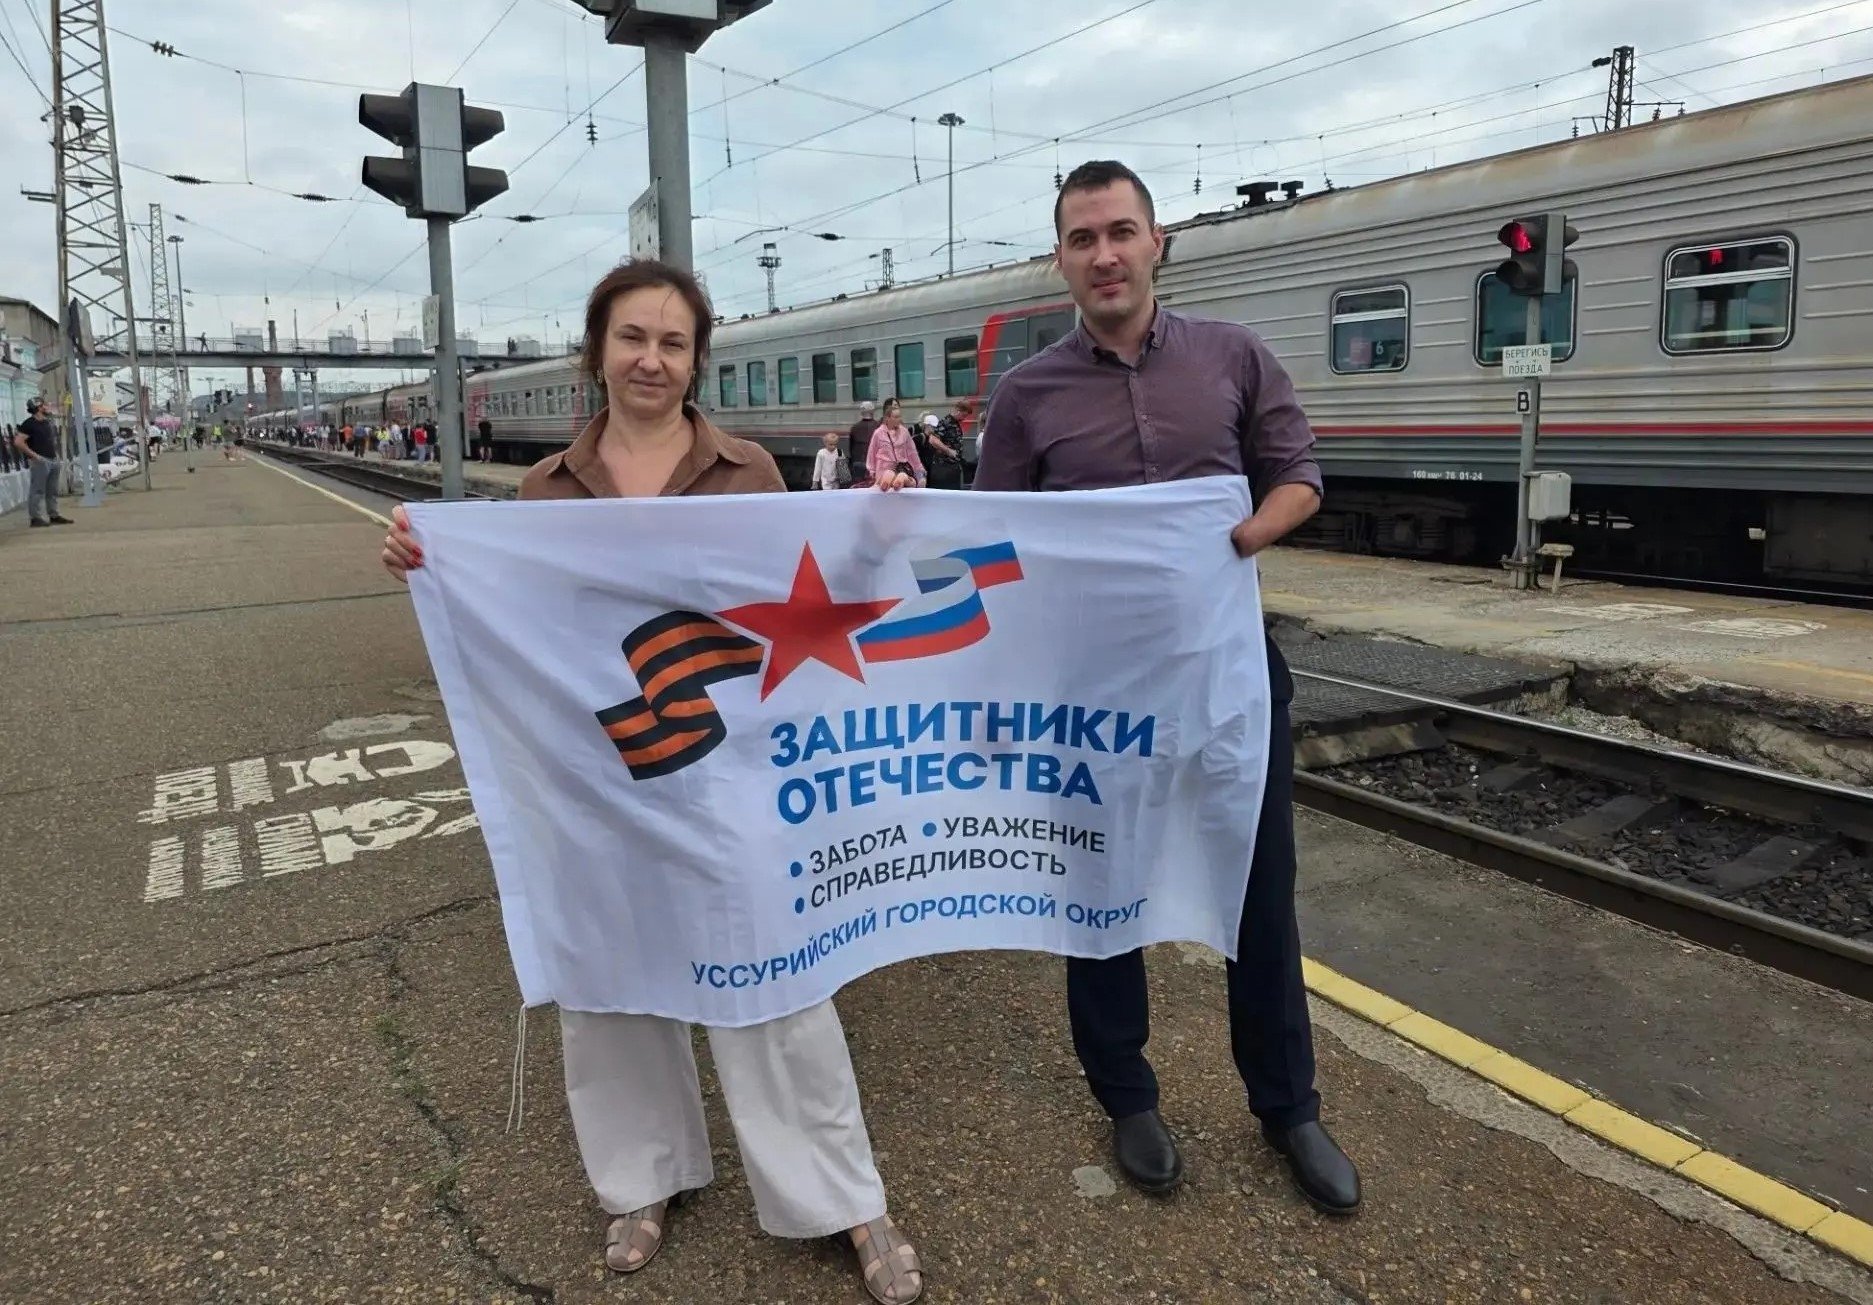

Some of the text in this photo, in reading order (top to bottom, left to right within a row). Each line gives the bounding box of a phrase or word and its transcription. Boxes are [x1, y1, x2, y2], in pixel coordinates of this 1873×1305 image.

[1505, 347, 1549, 359] БЕРЕГИСЬ
[1508, 364, 1544, 375] ПОЕЗДА
[1517, 391, 1530, 412] В
[769, 700, 1157, 768] ЗАЩИТНИКИ
[776, 750, 1104, 826] ОТЕЧЕСТВА
[809, 824, 908, 875] ЗАБОТА
[943, 816, 1107, 856] УВАЖЕНИЕ
[809, 848, 1067, 909] СПРАВЕДЛИВОСТЬ
[691, 892, 1148, 990] УССУРИЙСКИЙ ГОРОДСКОЙ ОКРУГ
